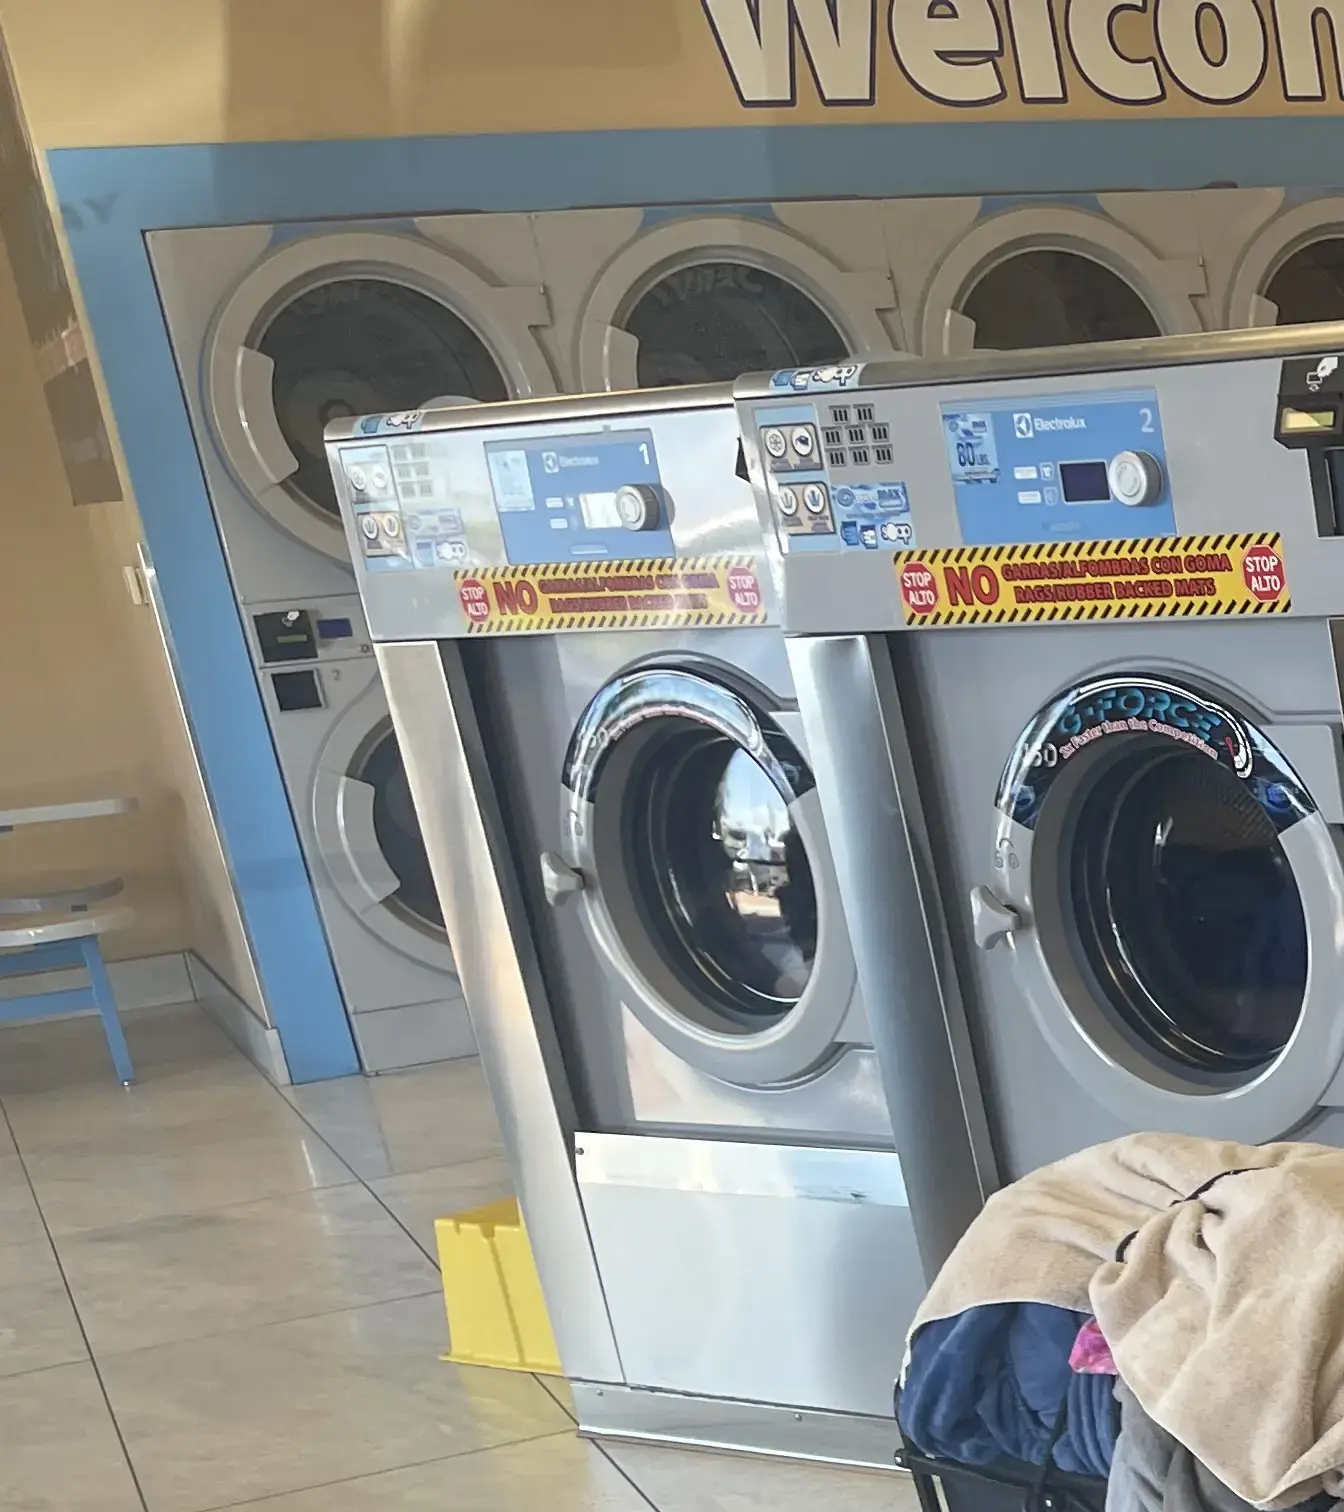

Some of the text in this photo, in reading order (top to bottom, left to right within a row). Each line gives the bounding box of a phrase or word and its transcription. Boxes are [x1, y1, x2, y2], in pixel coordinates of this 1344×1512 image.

[1034, 416, 1087, 432] Electrolux
[1139, 408, 1155, 433] 2
[639, 443, 650, 465] 1
[956, 442, 975, 467] 80
[1151, 555, 1182, 576] CON
[1184, 552, 1233, 573] GOMA
[1245, 556, 1279, 573] STOP
[728, 575, 754, 591] STOP
[903, 571, 932, 589] STOP
[943, 564, 1000, 607] NO
[1116, 580, 1173, 600] BACKED
[1174, 577, 1217, 597] MATS
[1250, 574, 1281, 593] ALTO
[461, 586, 485, 601] STOP
[492, 580, 539, 617] NO
[733, 591, 759, 607] ALTO
[909, 589, 935, 607] ALTO
[467, 602, 489, 617] ALTO
[1058, 688, 1222, 741] G-FORCE
